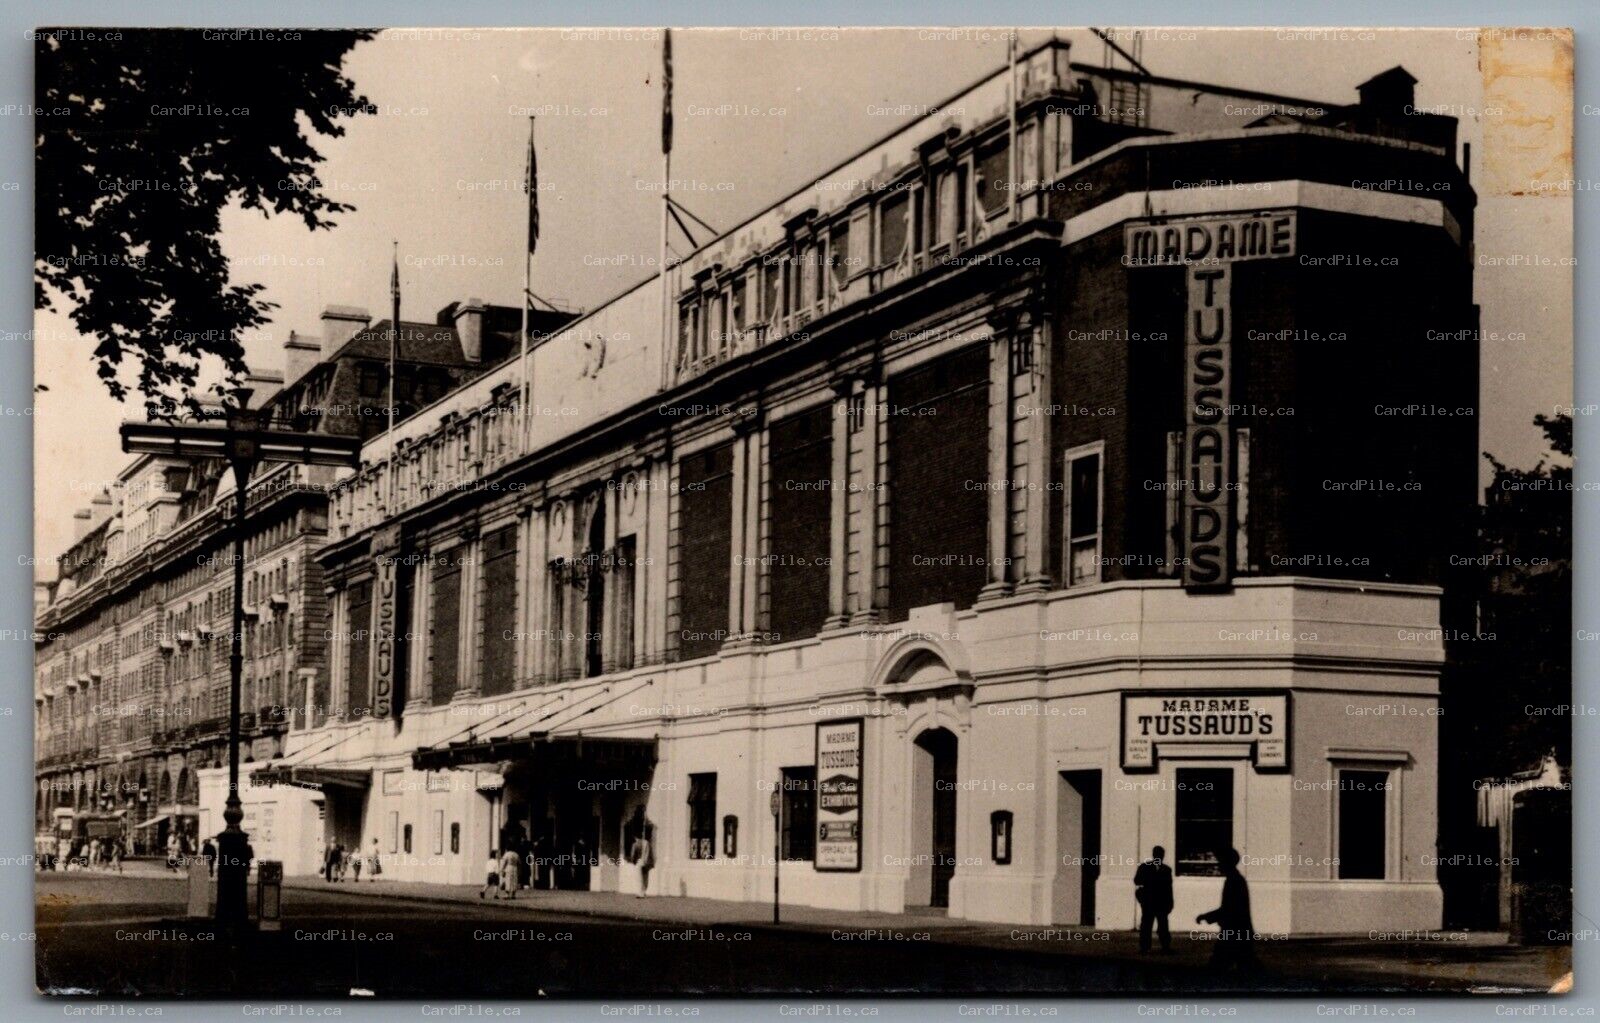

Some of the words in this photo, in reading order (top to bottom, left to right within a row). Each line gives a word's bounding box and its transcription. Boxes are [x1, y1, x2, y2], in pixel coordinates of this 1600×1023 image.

[1133, 216, 1291, 264] MADAME
[1190, 269, 1225, 583] TUSSAUDS
[1138, 711, 1273, 735] TUSSAUD'S
[1163, 699, 1250, 712] MADAME
